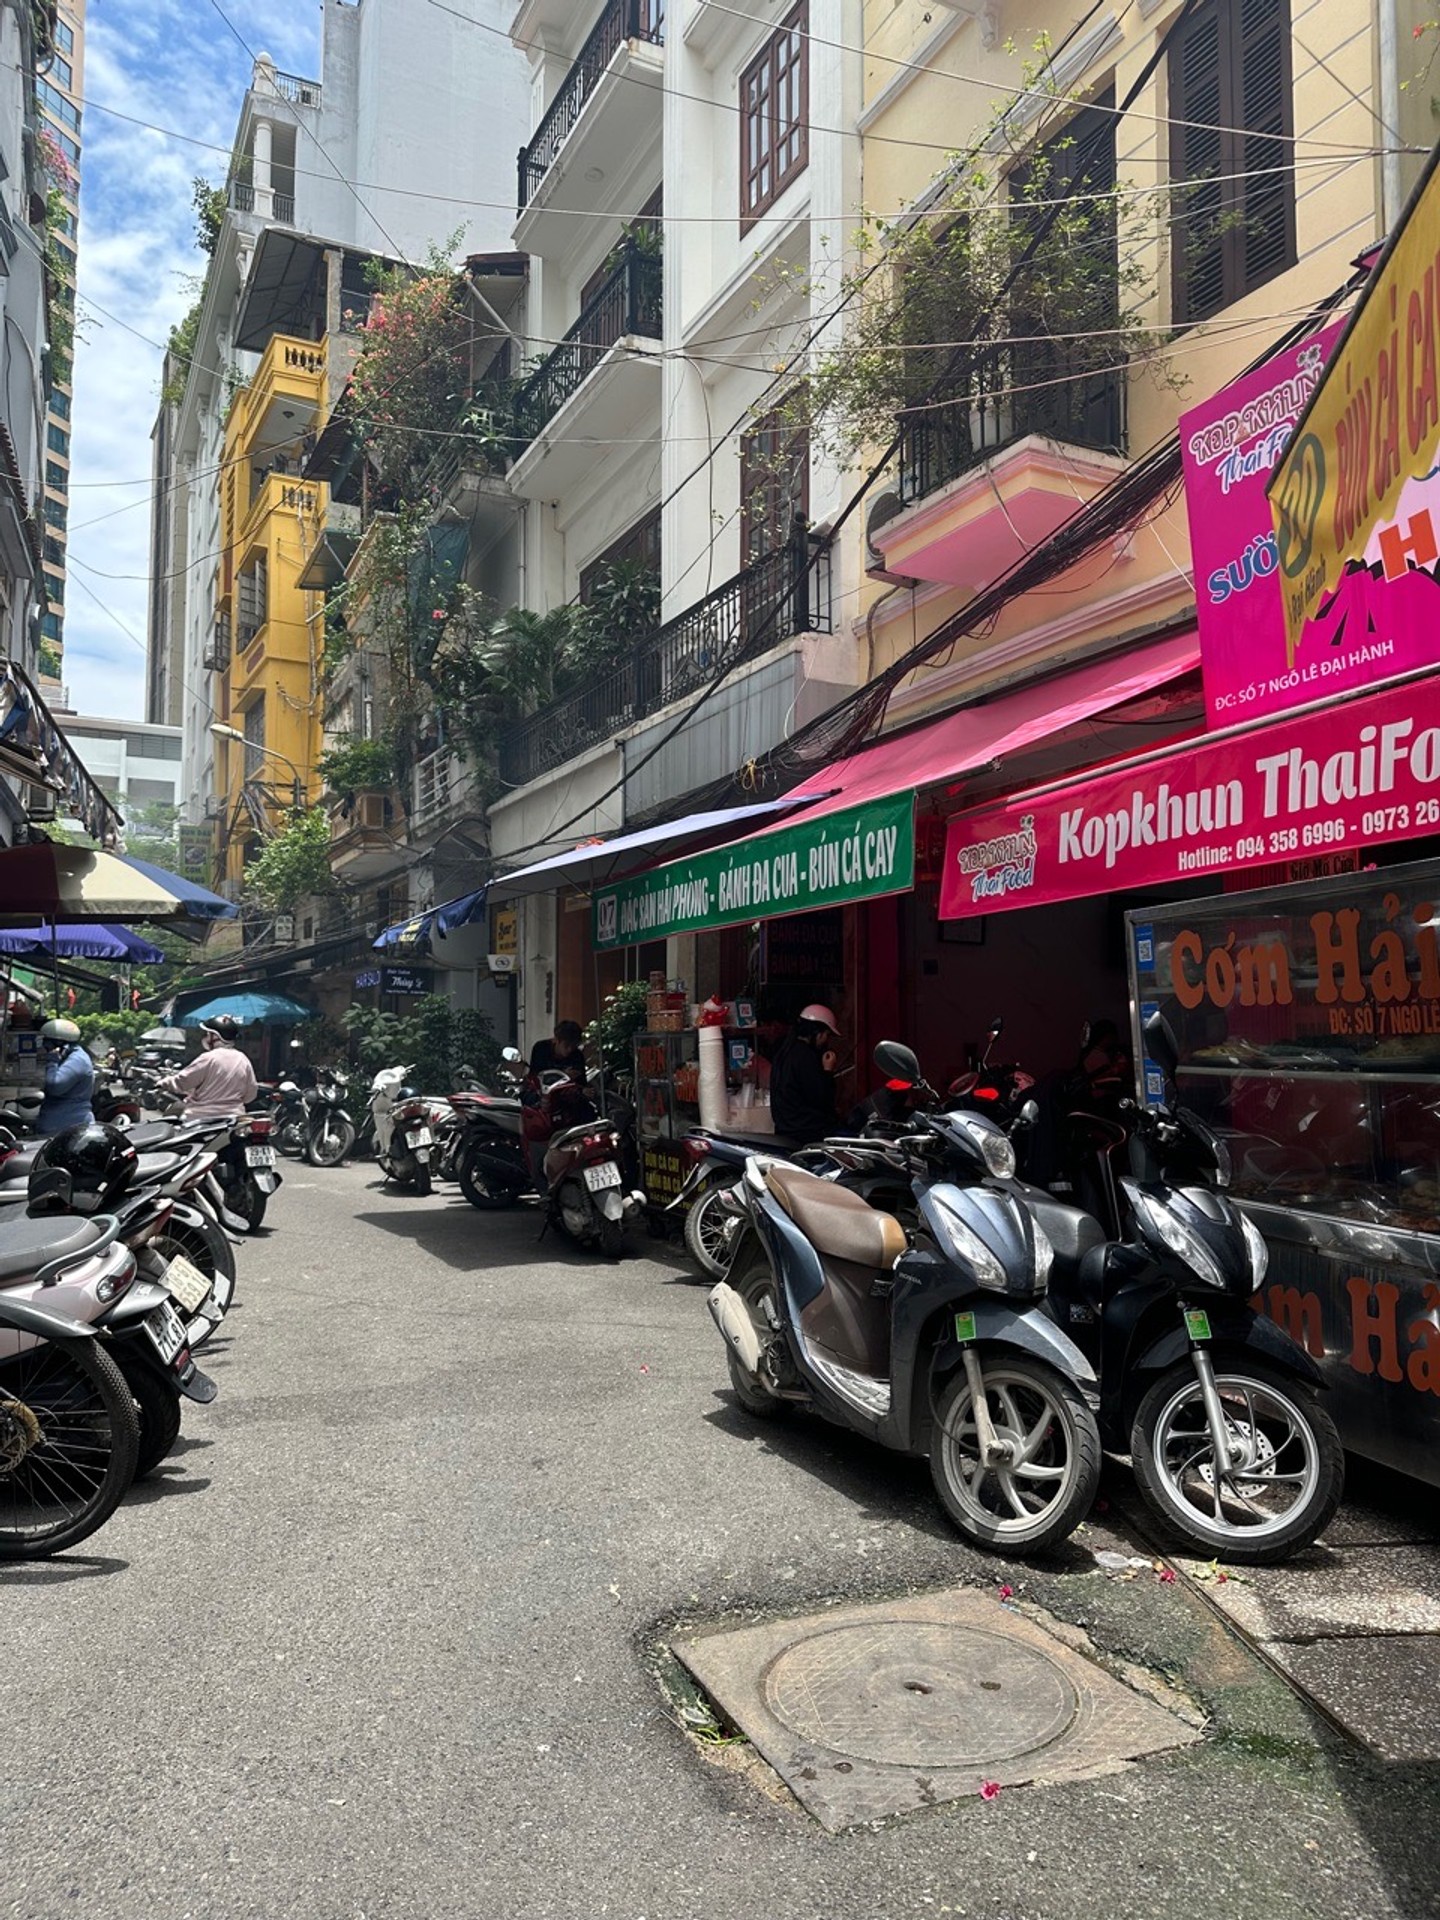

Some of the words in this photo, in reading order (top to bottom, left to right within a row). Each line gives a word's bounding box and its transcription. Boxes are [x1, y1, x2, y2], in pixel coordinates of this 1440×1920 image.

[1375, 282, 1400, 500] CÁ
[1407, 246, 1440, 456] CA
[1215, 445, 1264, 493] Thai
[1209, 533, 1281, 603] SƯỜ
[1215, 694, 1237, 710] ĐC:
[1239, 683, 1256, 703] SỐ
[1259, 684, 1266, 697] 7
[1302, 663, 1318, 682] LÊ
[1320, 655, 1347, 676] ĐẠI
[1349, 639, 1394, 667] HÀNH
[1058, 782, 1241, 868] Kopkhun
[1178, 846, 1233, 871] Hotline:
[1236, 836, 1265, 860] 094
[1269, 827, 1299, 854] 358
[1302, 818, 1345, 847] 6996
[1362, 805, 1410, 835] 0973
[672, 870, 709, 922] PHÒNG
[718, 857, 750, 912] BÁNH
[752, 859, 770, 904] ĐA
[773, 852, 798, 898] CUA
[808, 830, 839, 893] BÚN
[842, 821, 861, 884] CÁ
[864, 825, 897, 879] CAY
[971, 869, 1001, 901] Thai
[1000, 858, 1034, 896] Food
[1329, 1007, 1352, 1034] ĐC:
[1377, 1007, 1386, 1034] 7
